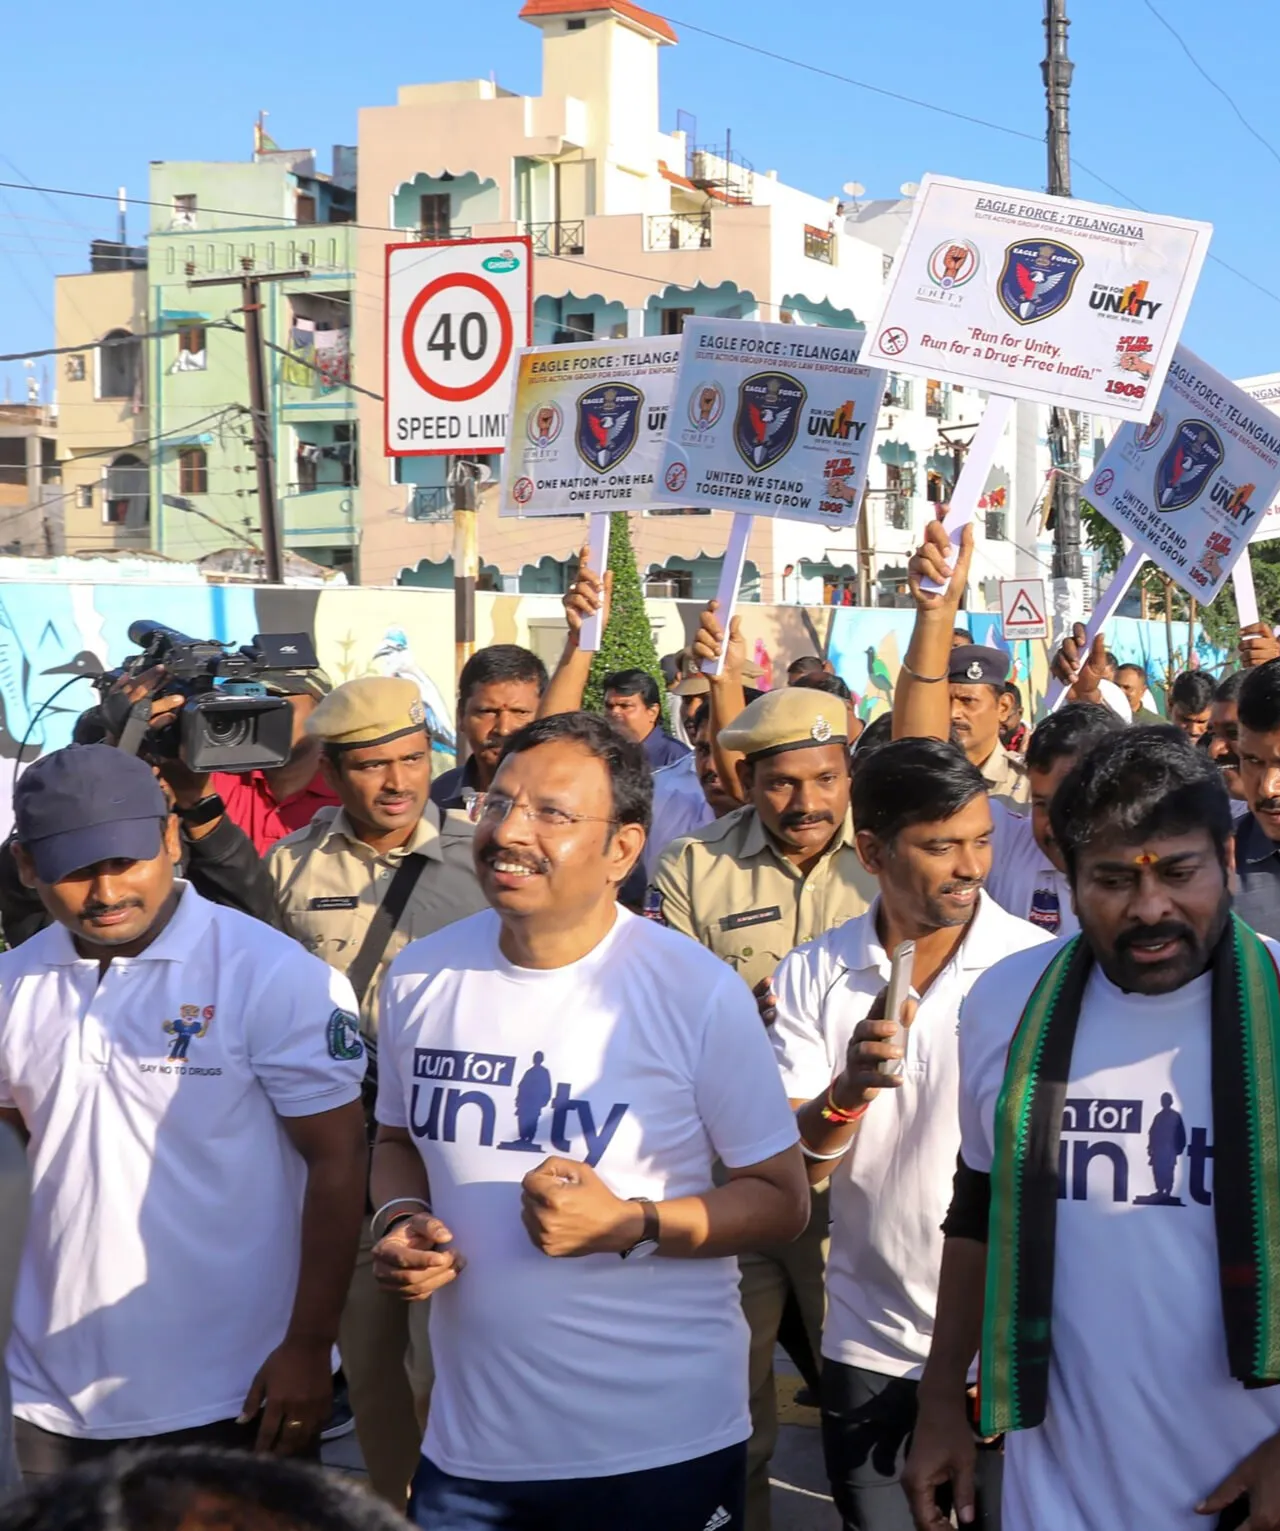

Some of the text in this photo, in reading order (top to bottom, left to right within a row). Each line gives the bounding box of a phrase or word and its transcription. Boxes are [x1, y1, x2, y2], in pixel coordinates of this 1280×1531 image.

[976, 198, 1016, 214] EAGLE
[1018, 205, 1058, 222] FORCE
[1067, 214, 1144, 238] TELANGANA
[993, 216, 1016, 225] ACTION
[1018, 220, 1040, 229] GROUP
[1054, 227, 1073, 235] DRUG
[1088, 233, 1137, 247] ENFORCEMENT
[1012, 248, 1077, 264] EAGLE FORCE
[427, 311, 488, 361] 40
[699, 335, 737, 350] EAGLE
[739, 339, 781, 354] FORCE
[790, 344, 860, 362] TELANGAN
[1000, 333, 1021, 348] for
[1024, 338, 1061, 358] Unity.
[531, 359, 569, 374] EAGLE
[572, 356, 613, 371] FORCE
[623, 351, 679, 366] TELANGA
[715, 353, 738, 362] ACTION
[740, 356, 763, 365] GROUP
[763, 358, 777, 367] FOR
[778, 359, 796, 368] DRUG
[798, 362, 813, 370] LAW
[920, 334, 947, 351] Run
[949, 340, 970, 355] for
[972, 347, 982, 357] a
[984, 347, 1054, 372] Drug-Free
[574, 372, 597, 381] GROUP
[599, 370, 612, 379] FOR
[613, 369, 631, 377] DRUG
[745, 385, 801, 397] EAGLE FORCE
[1105, 380, 1146, 399] 1908
[1193, 380, 1224, 409] FORCE
[397, 413, 509, 441] SPEED LIMI
[537, 479, 556, 489] ONE
[559, 477, 597, 488] NATION
[608, 475, 630, 486] ONE
[633, 474, 654, 484] HEA
[569, 488, 632, 501] ONE FUTURE
[706, 470, 804, 493] UNITED WE STAND
[696, 482, 811, 509] TOGETHER WE GROW
[1111, 495, 1148, 534] TOGETHER
[1146, 527, 1160, 545] WE
[1160, 540, 1188, 567] GROW
[1123, 489, 1149, 516] UNITED
[1148, 511, 1160, 528] WE
[1160, 522, 1187, 549] STAND
[140, 1064, 222, 1076] SAY NO TO DRUGS
[417, 1053, 507, 1082] run for
[1088, 1100, 1133, 1129] for
